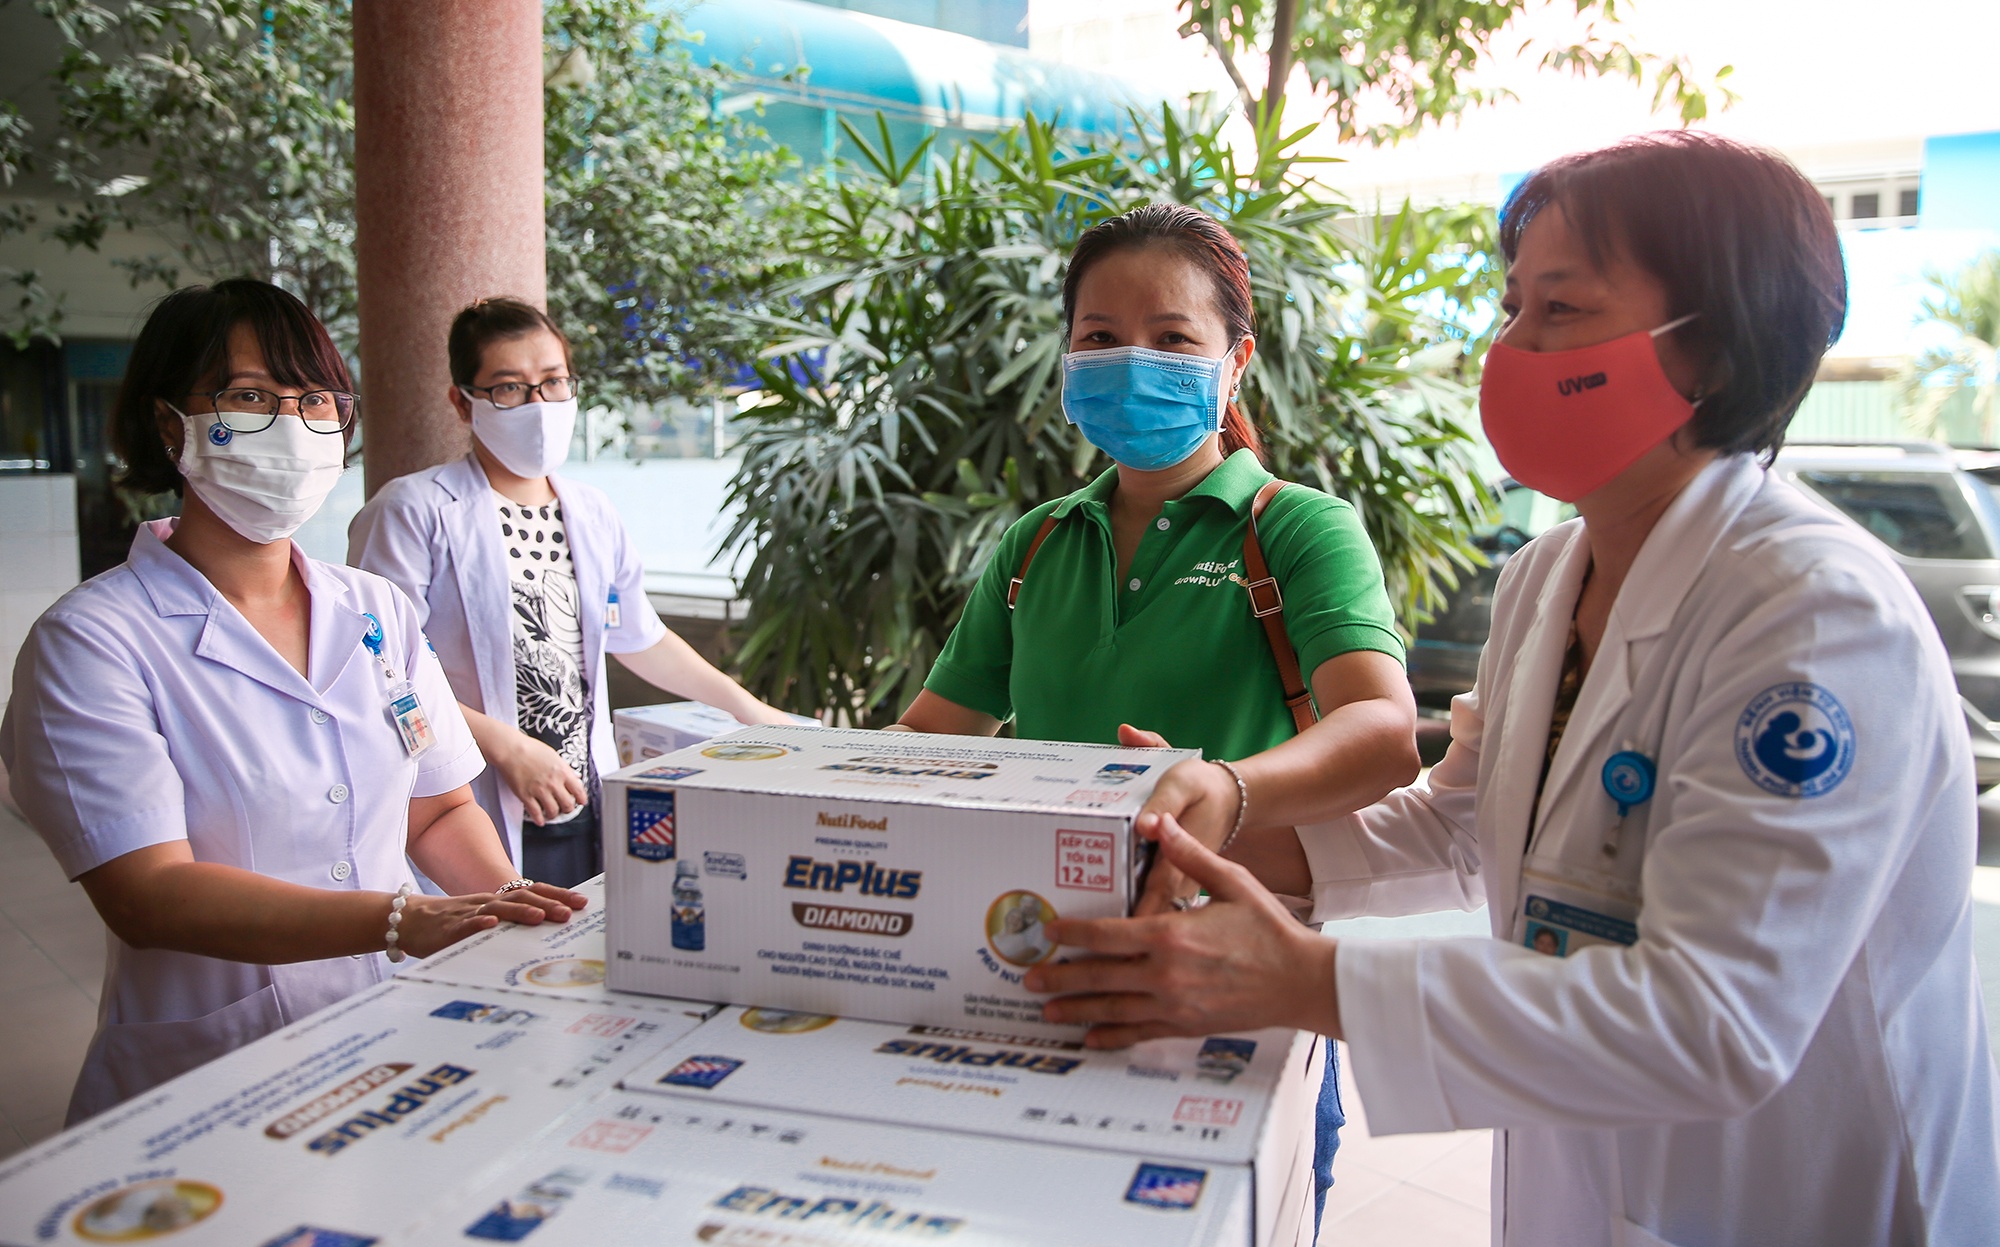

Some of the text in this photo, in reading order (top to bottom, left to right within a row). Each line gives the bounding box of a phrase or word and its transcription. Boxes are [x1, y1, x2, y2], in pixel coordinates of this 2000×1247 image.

[816, 811, 888, 832] NutiFood
[1085, 838, 1110, 851] CAO
[783, 855, 923, 900] EnPlus
[1062, 867, 1084, 884] 12
[803, 906, 904, 934] DIAMOND
[976, 947, 999, 973] PRO
[875, 1039, 1086, 1076] EnPlus
[305, 1062, 478, 1157] EnPlus
